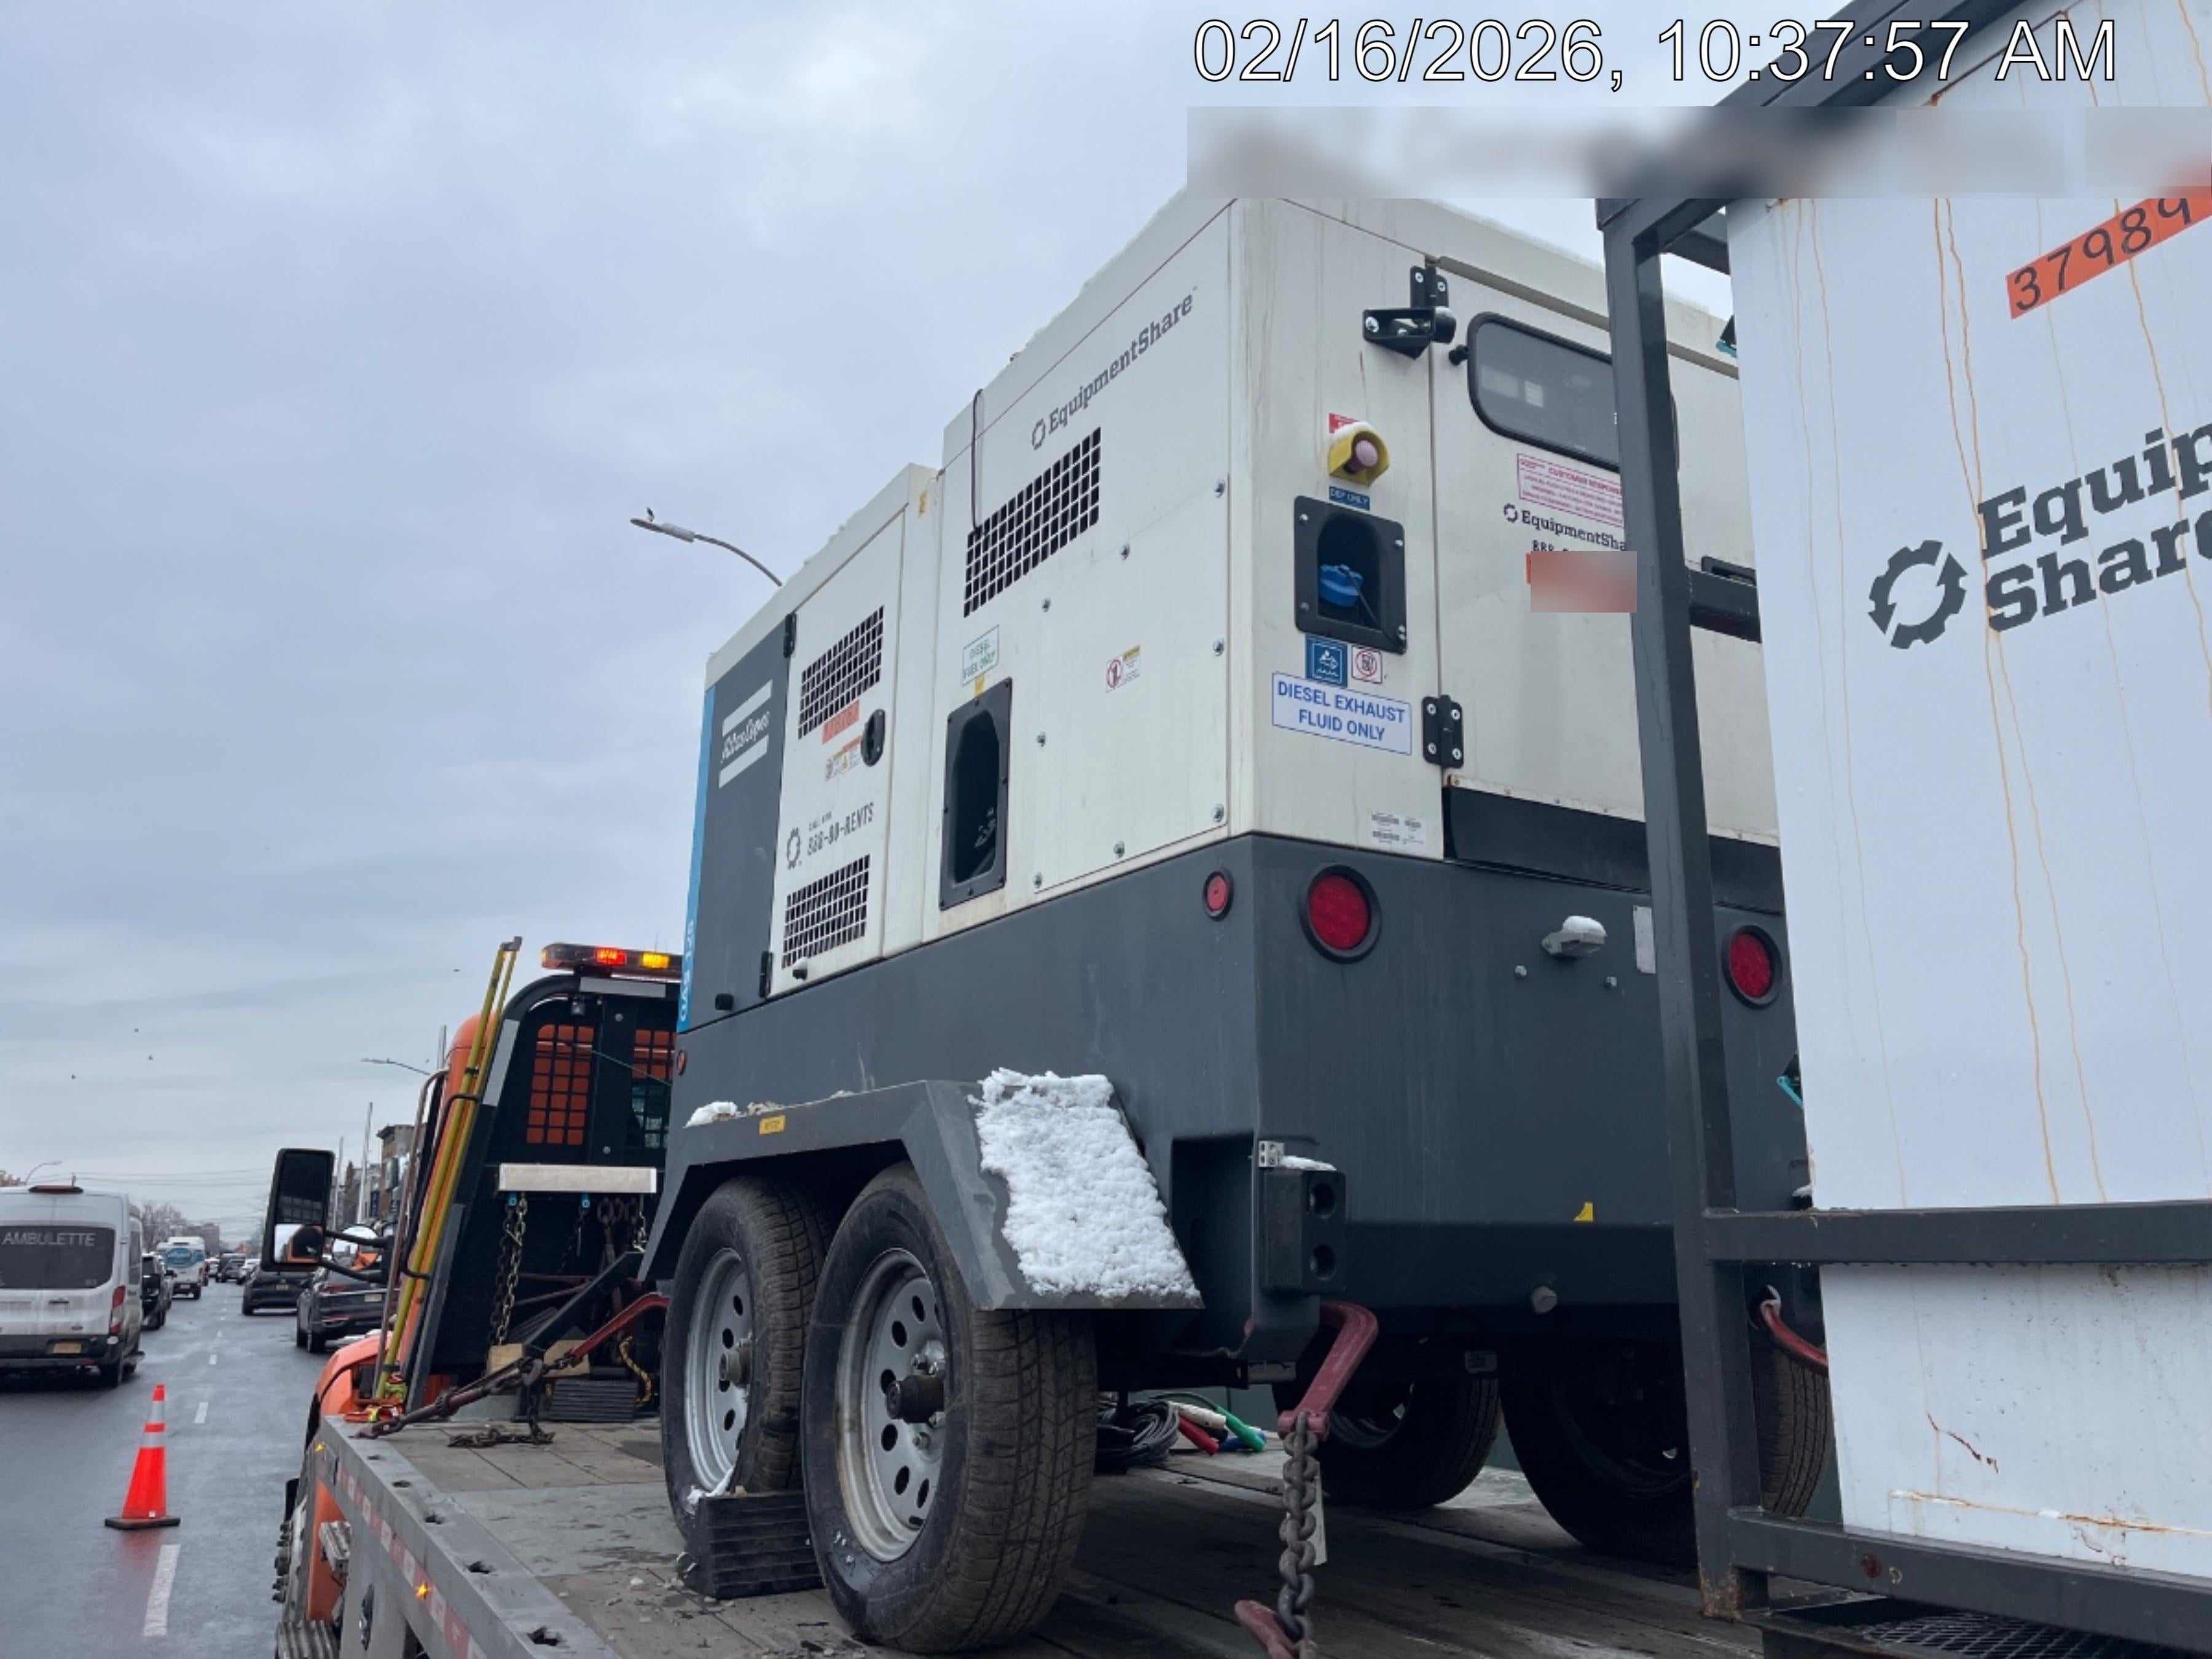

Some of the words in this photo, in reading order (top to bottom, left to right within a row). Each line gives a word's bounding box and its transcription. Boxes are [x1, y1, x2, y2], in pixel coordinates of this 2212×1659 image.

[1048, 294, 1193, 435] EquipmentShare
[1278, 681, 1331, 707] DIESEL
[1335, 695, 1405, 723] EXHAUST
[1298, 709, 1343, 732] FLUID
[1346, 720, 1386, 742] ONLY
[1, 1232, 96, 1247] AMBULETTE
